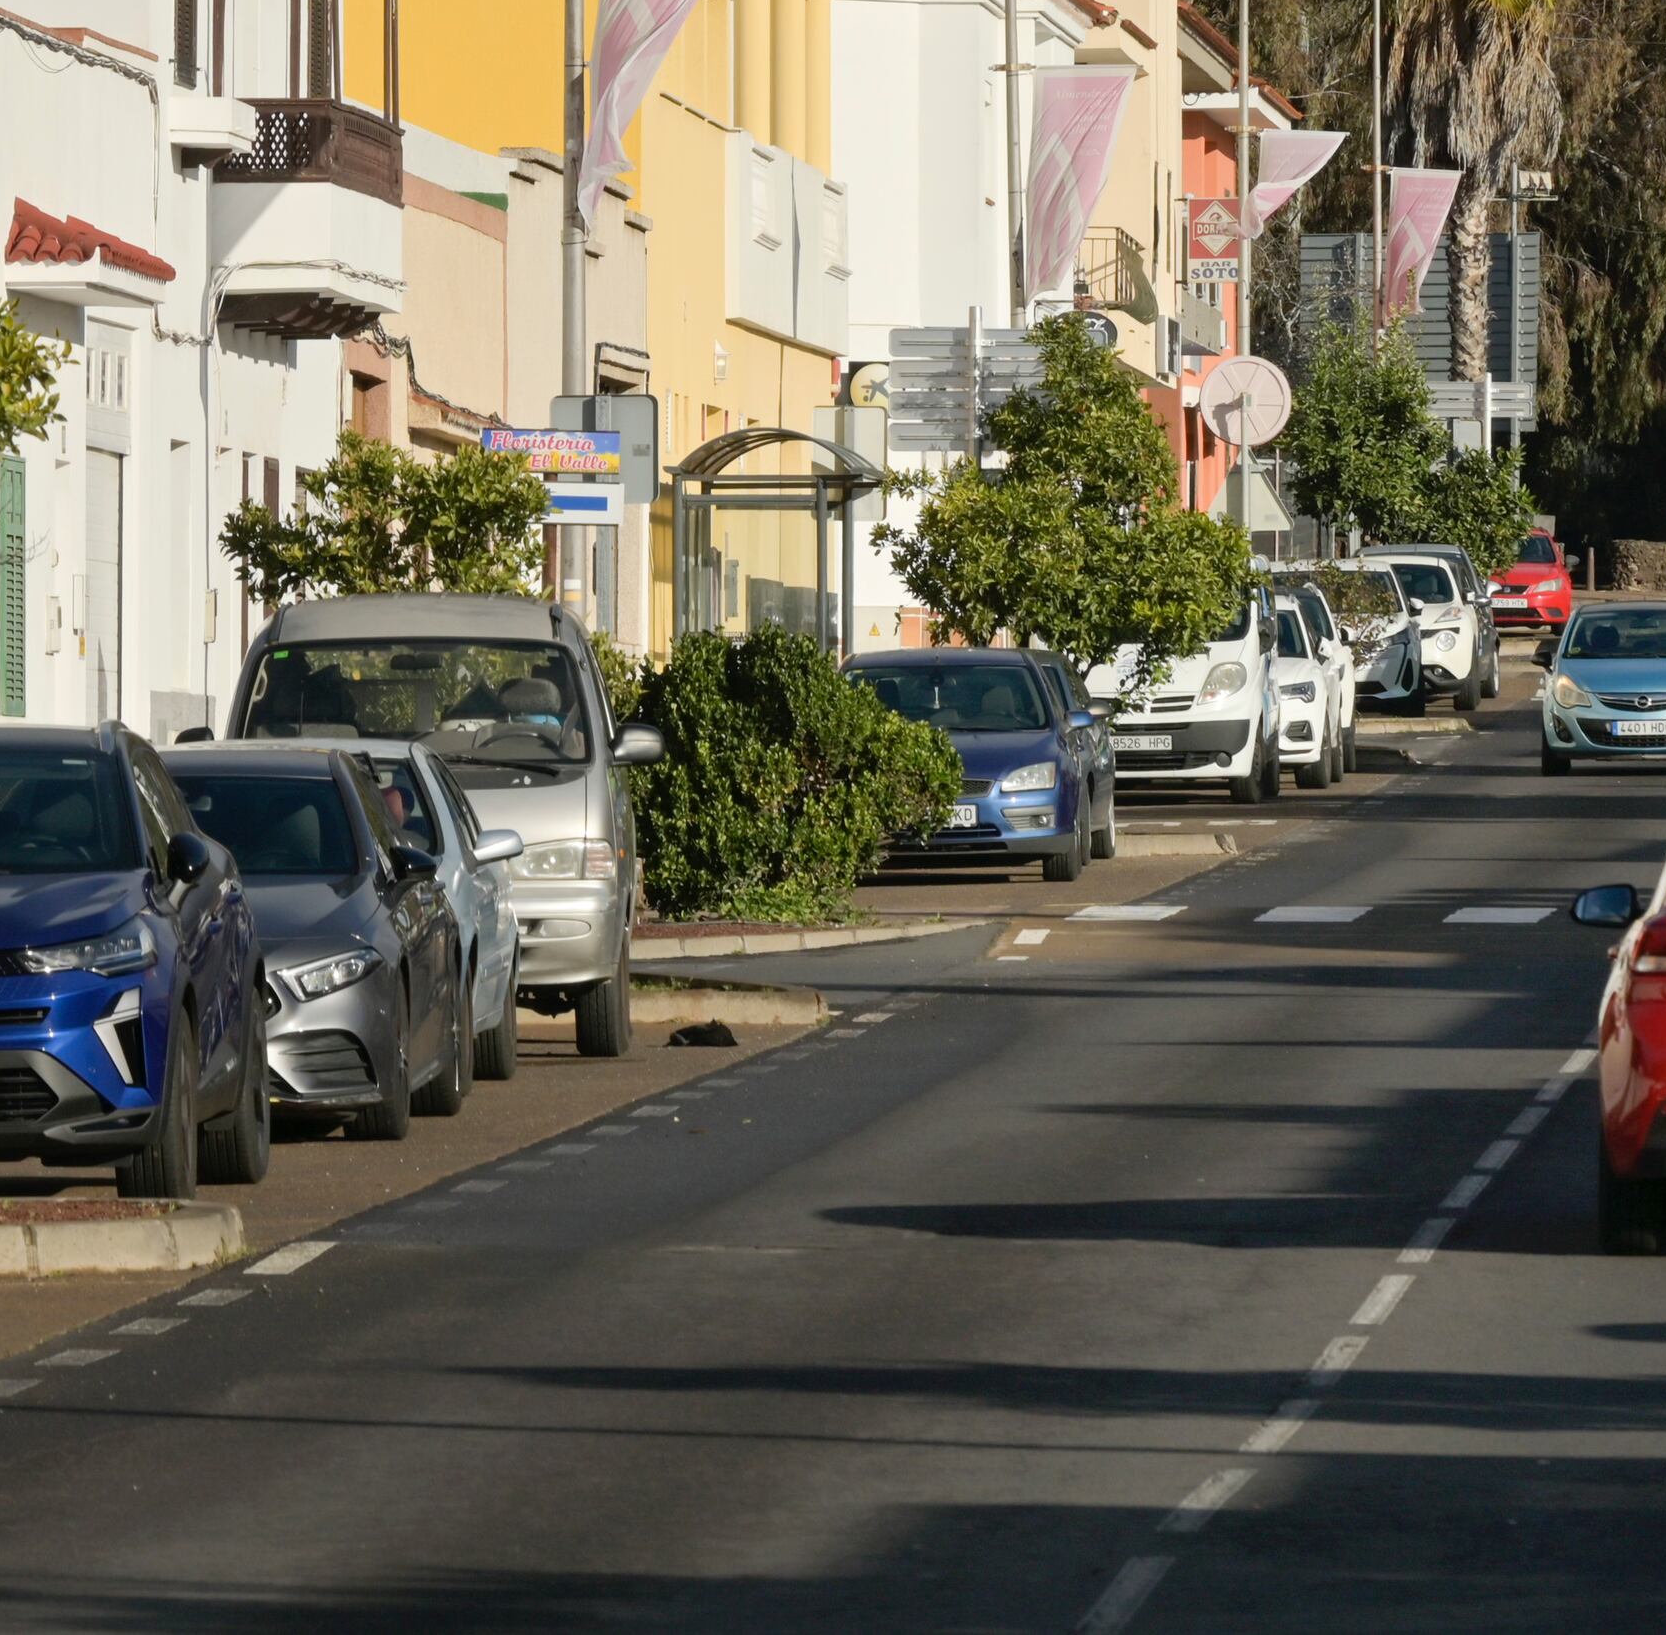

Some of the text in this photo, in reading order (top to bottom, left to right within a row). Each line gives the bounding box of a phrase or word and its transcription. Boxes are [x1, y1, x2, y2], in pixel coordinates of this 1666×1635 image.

[1191, 267, 1239, 280] SOTO
[530, 454, 608, 471] El Valle
[1620, 723, 1647, 733] 4401
[1113, 737, 1170, 749] 8526 HPG
